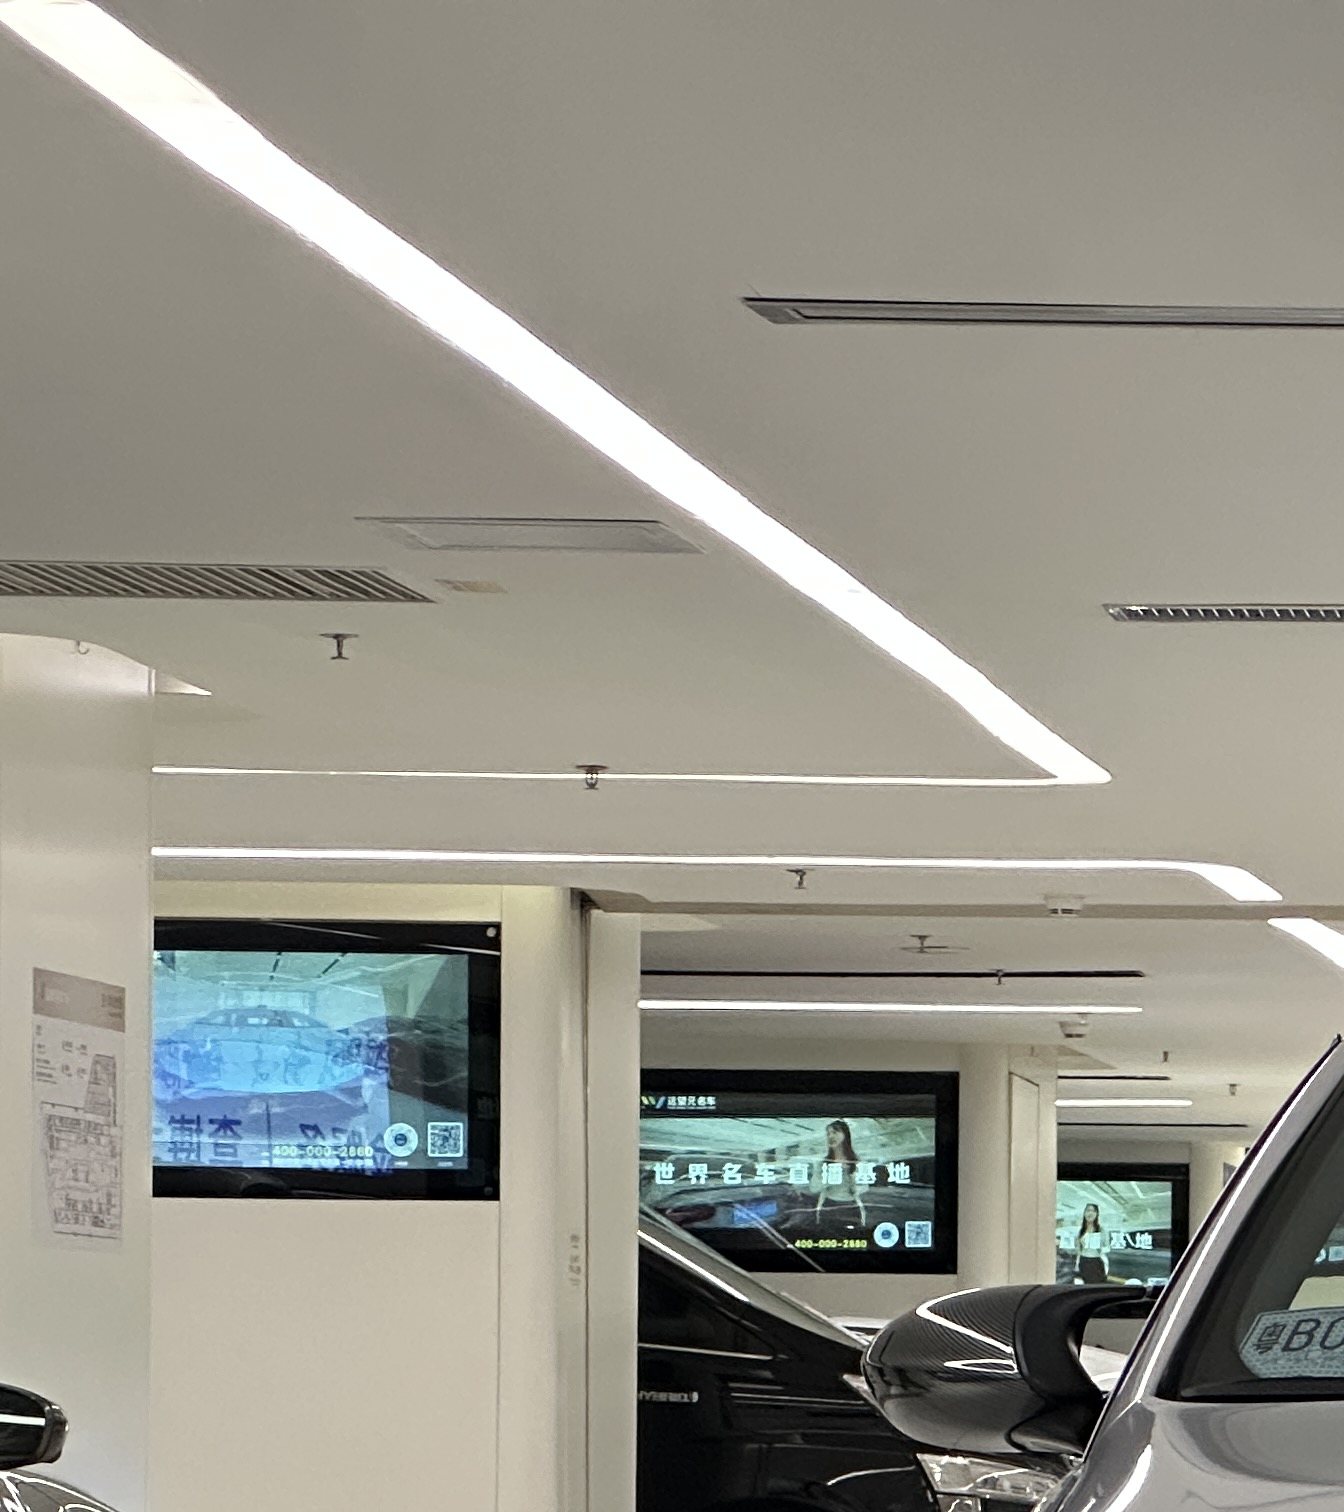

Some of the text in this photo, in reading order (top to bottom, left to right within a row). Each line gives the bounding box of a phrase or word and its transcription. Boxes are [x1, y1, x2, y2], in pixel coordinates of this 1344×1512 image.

[653, 1162, 912, 1185] 世界名车直播基地
